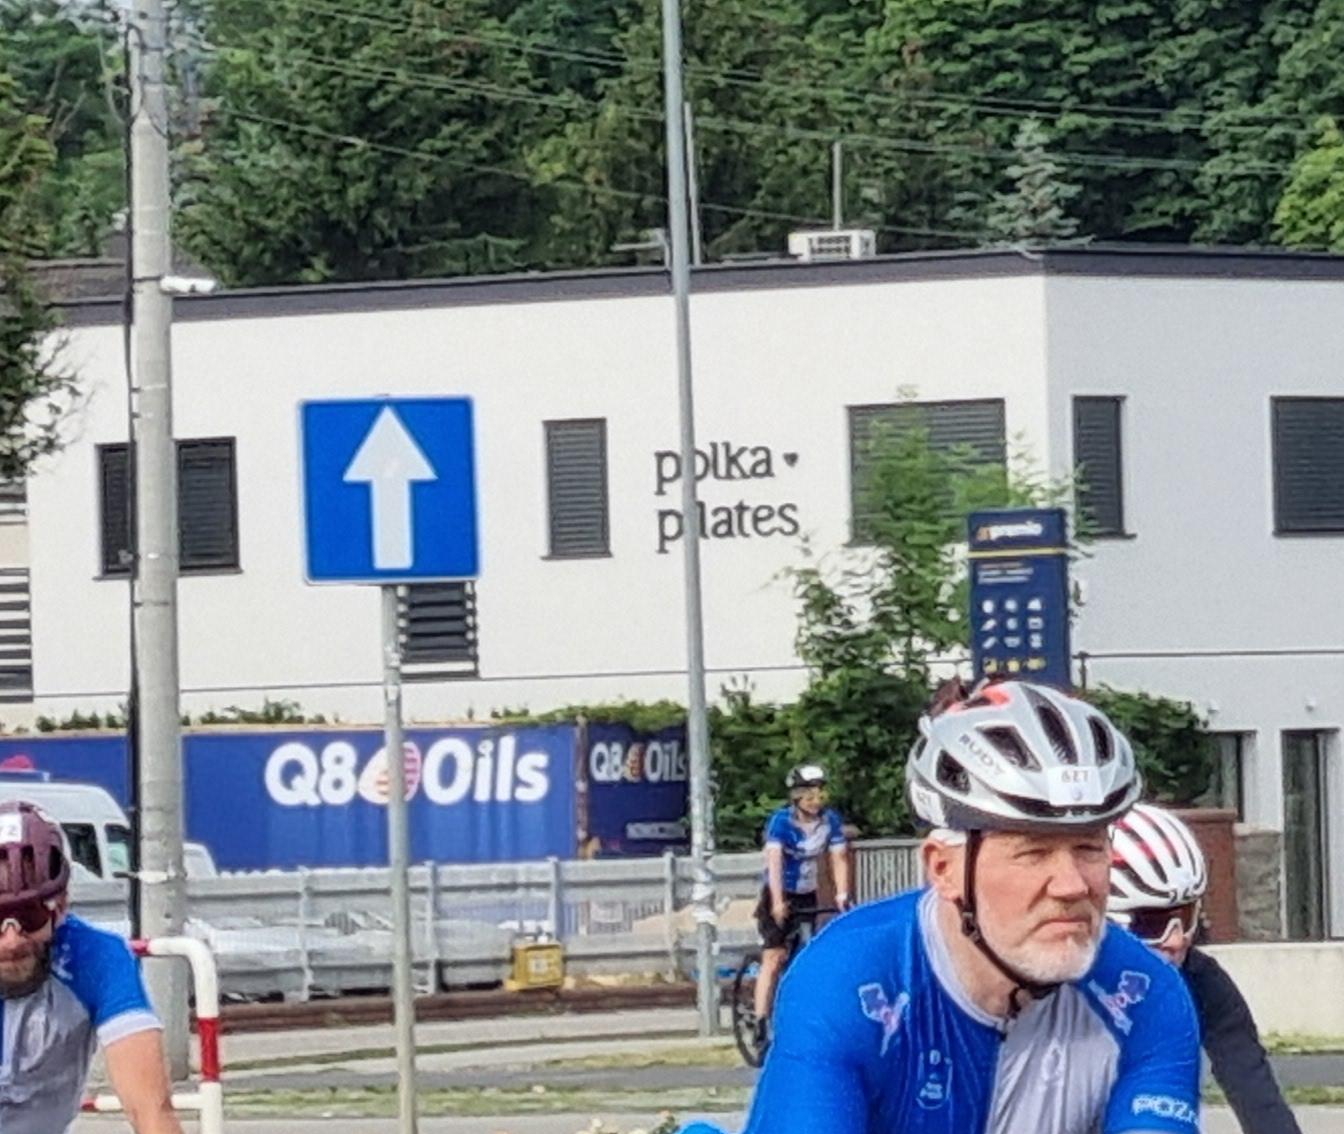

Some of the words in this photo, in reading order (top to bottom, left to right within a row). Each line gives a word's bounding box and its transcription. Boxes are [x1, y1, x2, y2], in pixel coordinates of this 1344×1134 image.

[654, 441, 775, 496] polka
[655, 499, 800, 554] plates
[264, 741, 357, 806] Q8
[422, 735, 549, 805] Oils
[589, 742, 624, 782] Q8
[645, 741, 688, 783] Oils
